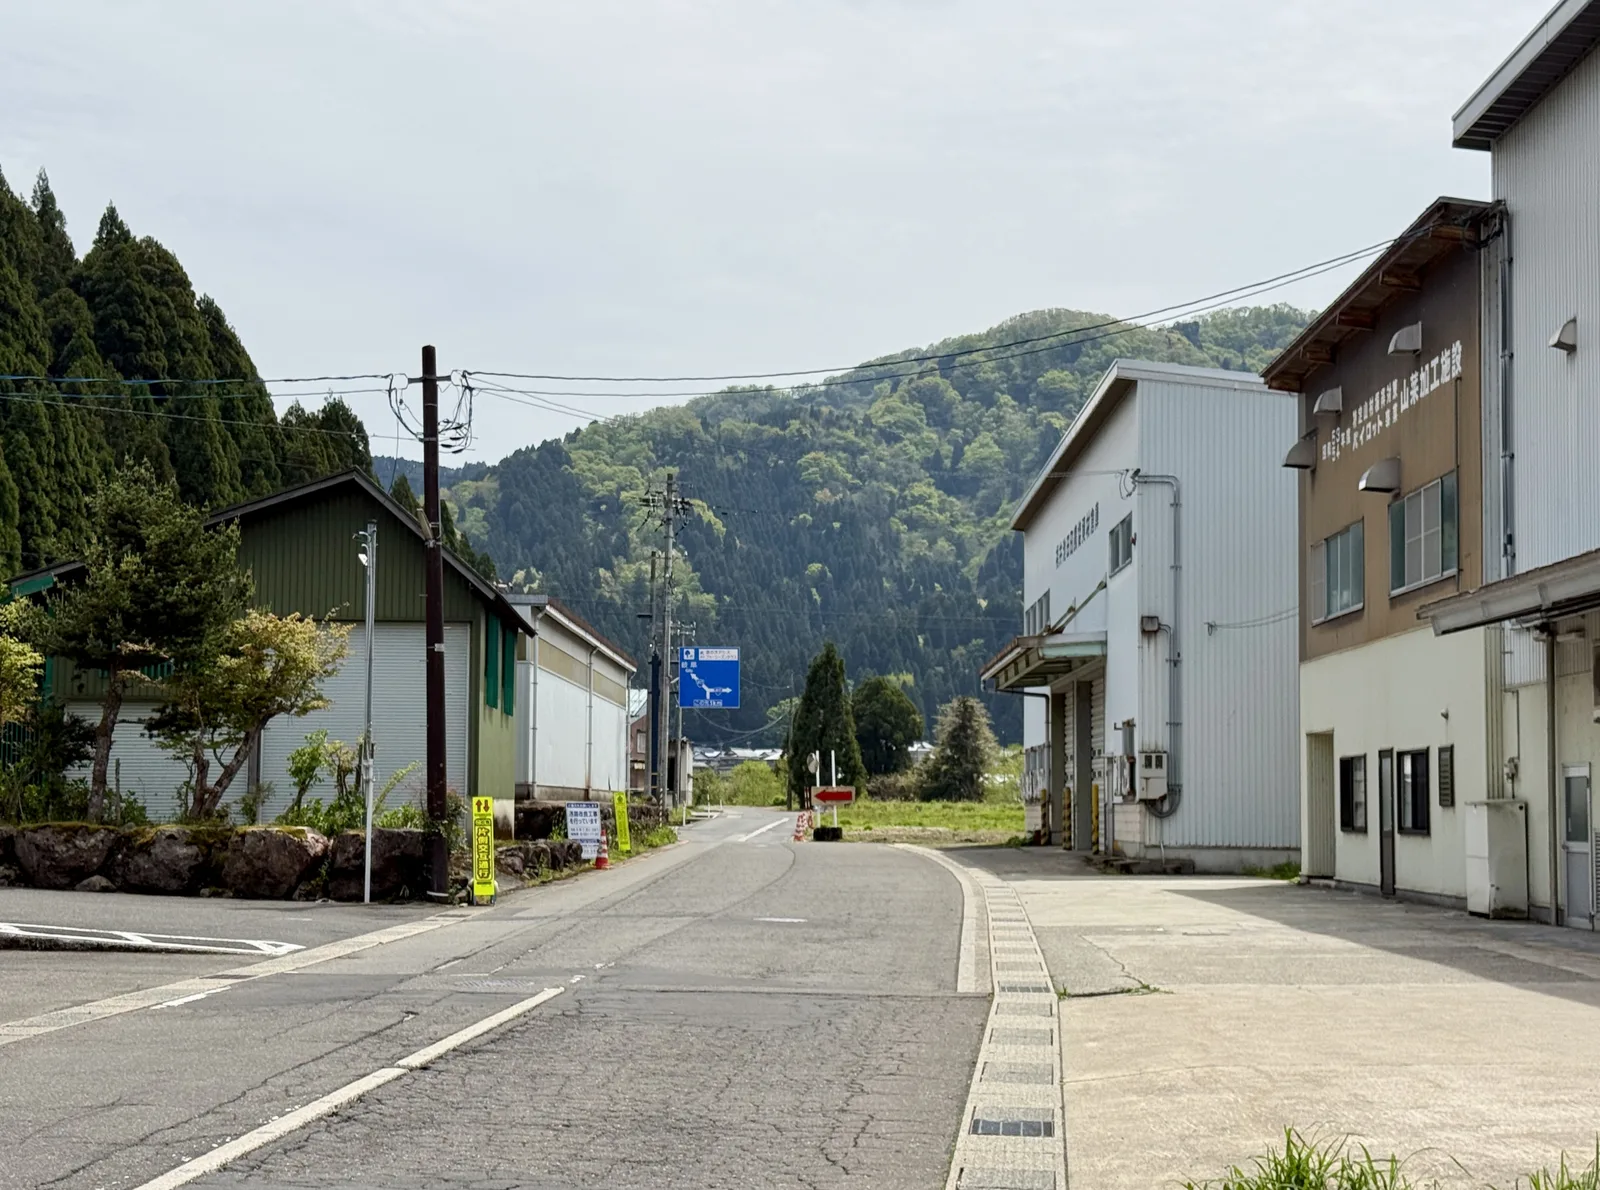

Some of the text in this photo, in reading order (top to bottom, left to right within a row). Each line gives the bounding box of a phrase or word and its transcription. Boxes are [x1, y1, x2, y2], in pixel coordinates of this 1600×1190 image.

[1400, 339, 1463, 413] 山菜加工施設
[477, 827, 490, 878] 片側交互通行
